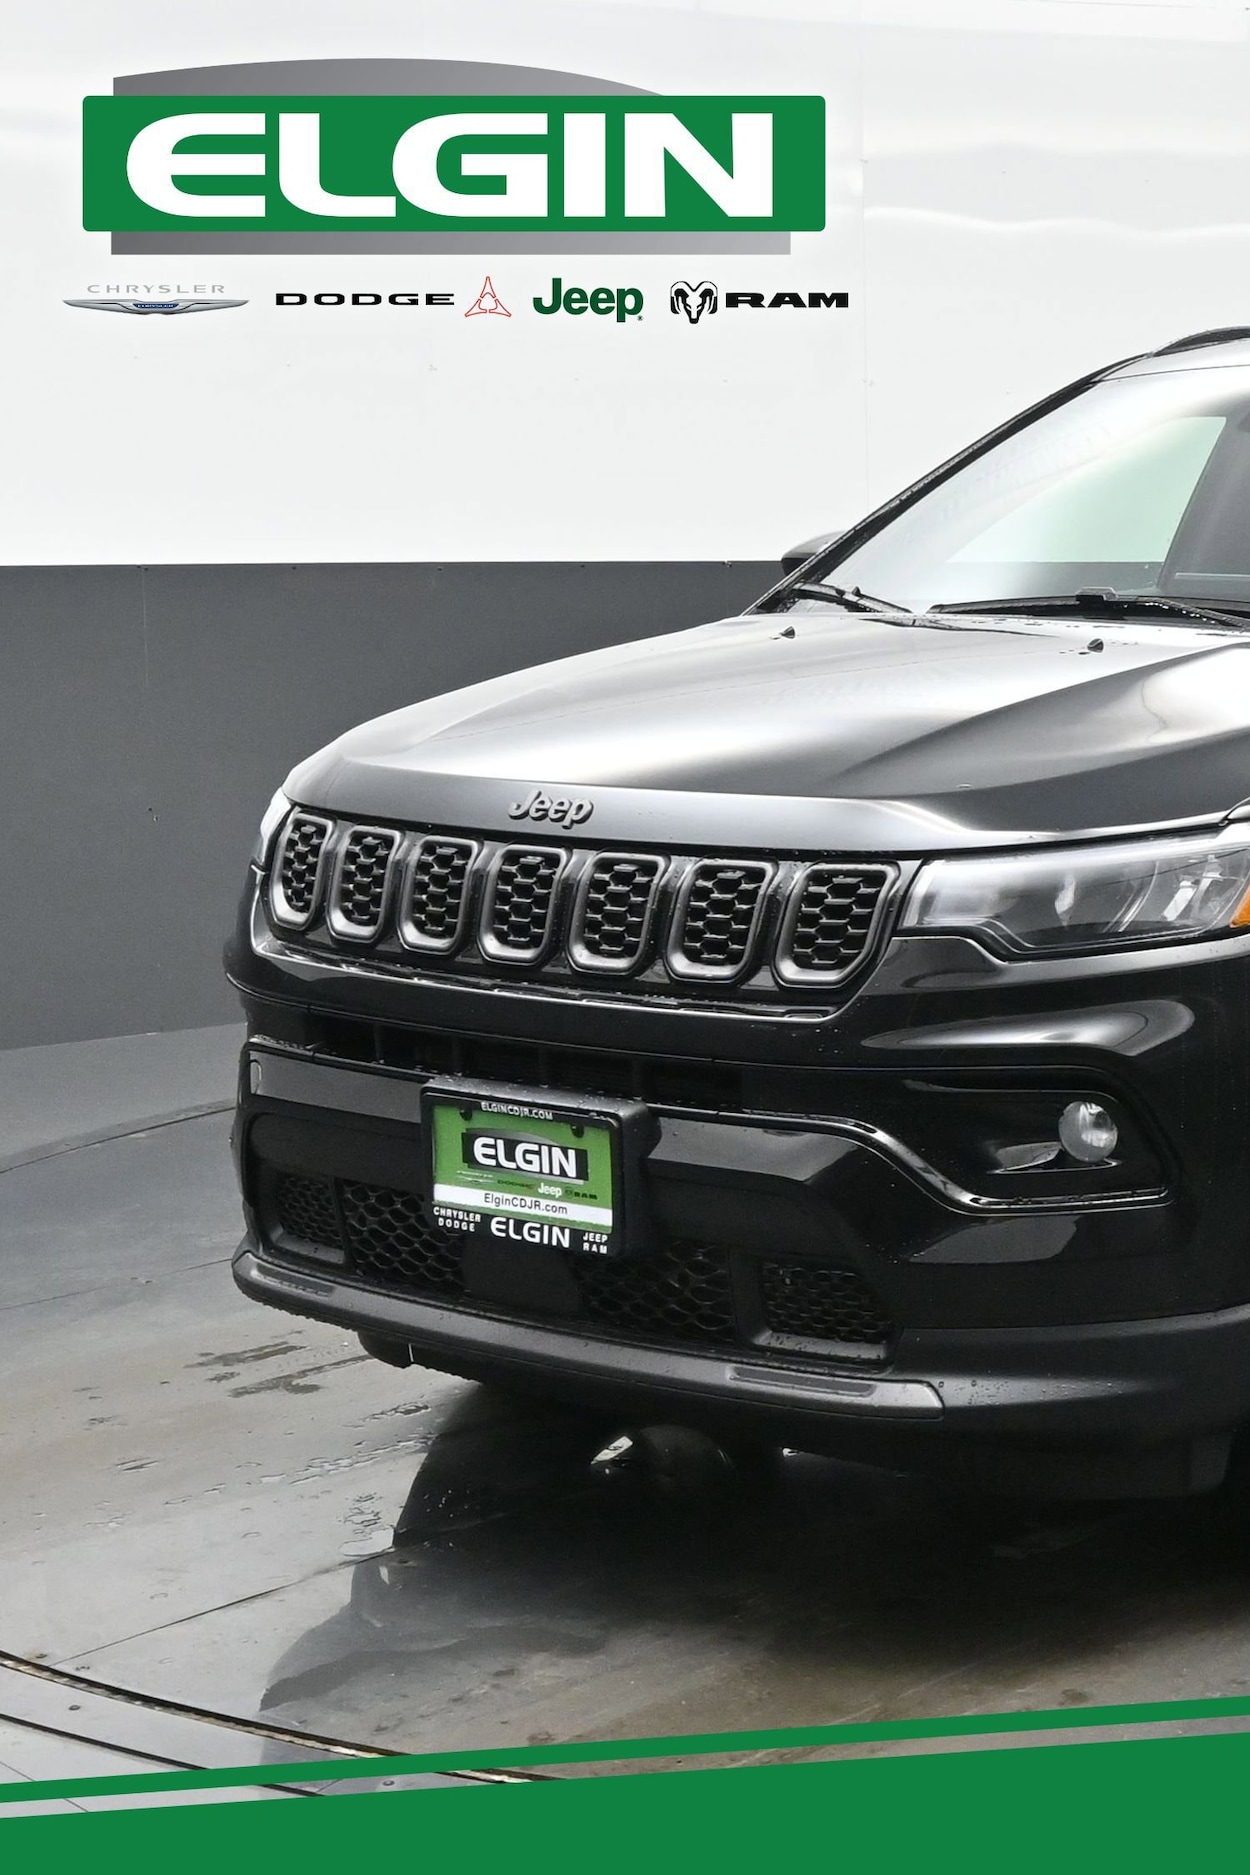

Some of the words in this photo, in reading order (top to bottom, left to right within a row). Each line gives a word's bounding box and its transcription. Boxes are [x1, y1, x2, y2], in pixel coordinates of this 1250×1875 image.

[508, 789, 594, 830] Jeep
[480, 1101, 553, 1120] ELGINCDJR.COM
[473, 1136, 577, 1179] ELGIN
[537, 1182, 562, 1198] Jeep
[484, 1192, 568, 1216] ElginCDJR.com
[433, 1206, 482, 1223] CHRYSLER
[438, 1218, 476, 1232] DODGE
[490, 1216, 571, 1249] ELGIN
[582, 1232, 608, 1244] JEEP
[583, 1242, 608, 1255] RAM
